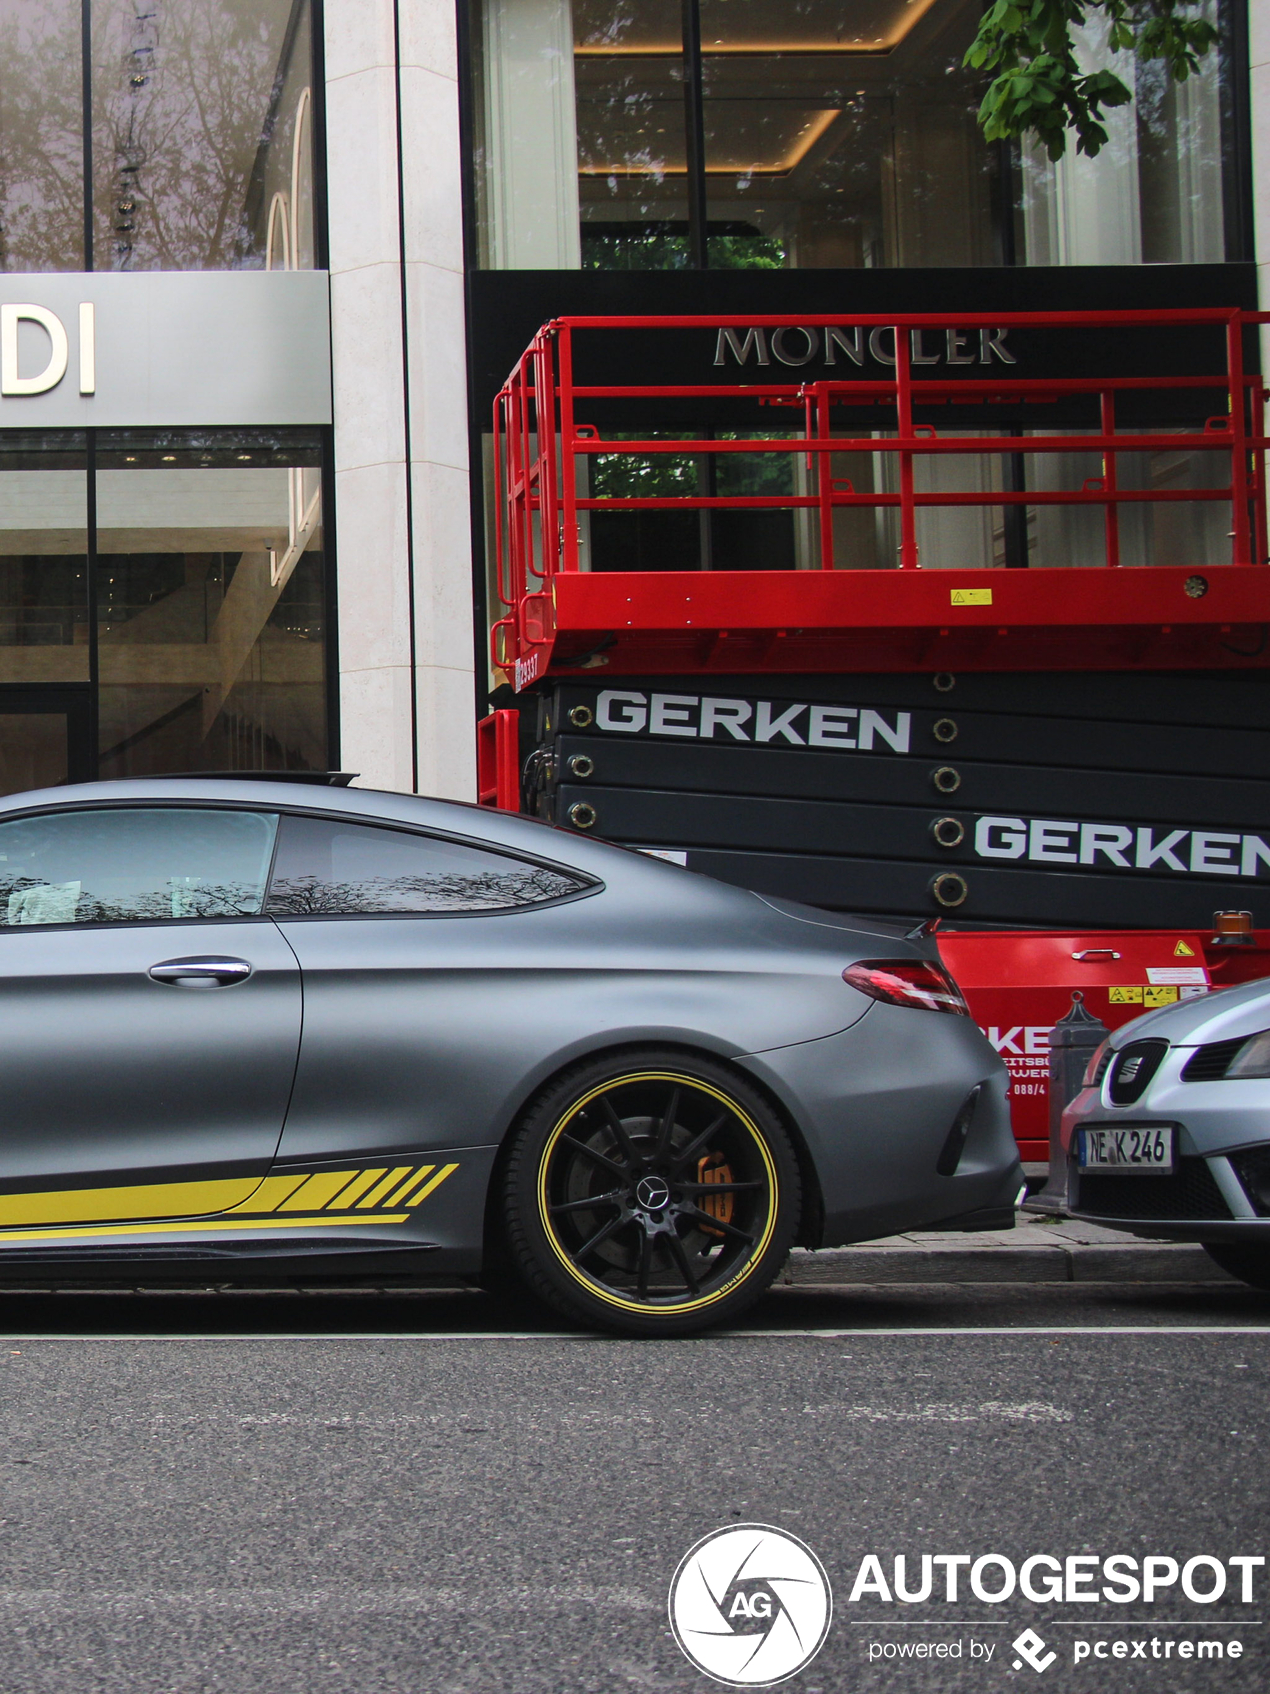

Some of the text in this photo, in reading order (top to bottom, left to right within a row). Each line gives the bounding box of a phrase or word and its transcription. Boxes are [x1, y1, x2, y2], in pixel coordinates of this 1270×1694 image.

[713, 325, 1017, 366] MONCLER
[595, 689, 911, 753] GERKEN
[1014, 1084, 1045, 1096] 088/4
[1091, 1130, 1164, 1162] NE K 246
